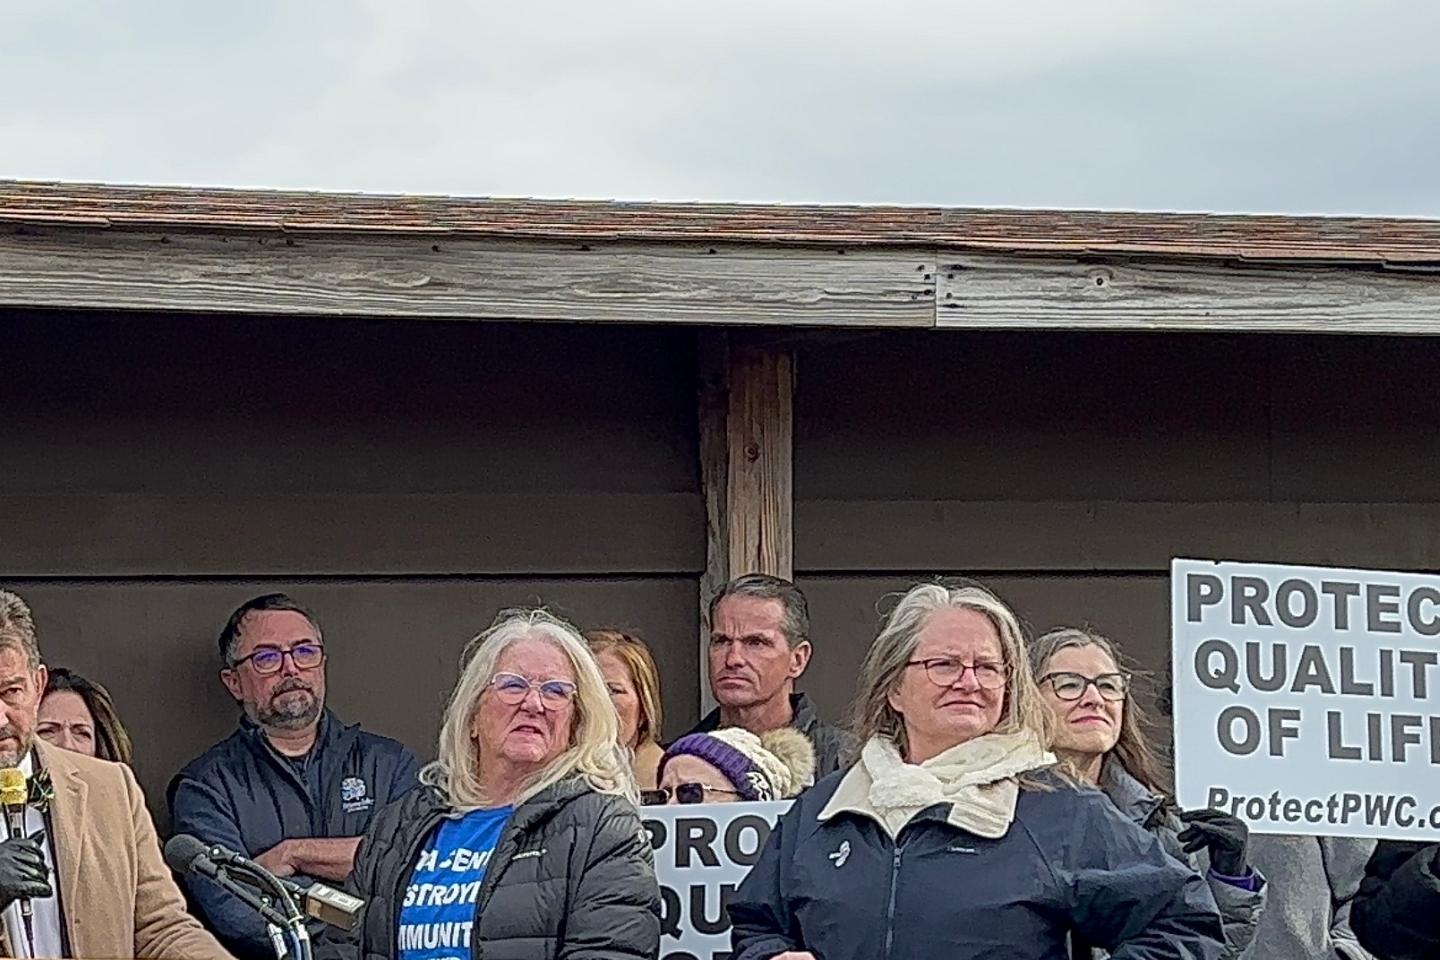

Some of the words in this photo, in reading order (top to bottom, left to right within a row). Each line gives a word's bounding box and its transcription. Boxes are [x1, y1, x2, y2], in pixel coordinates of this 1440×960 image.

[1216, 705, 1302, 757] OF
[641, 814, 773, 868] PRO
[660, 884, 738, 941] QU
